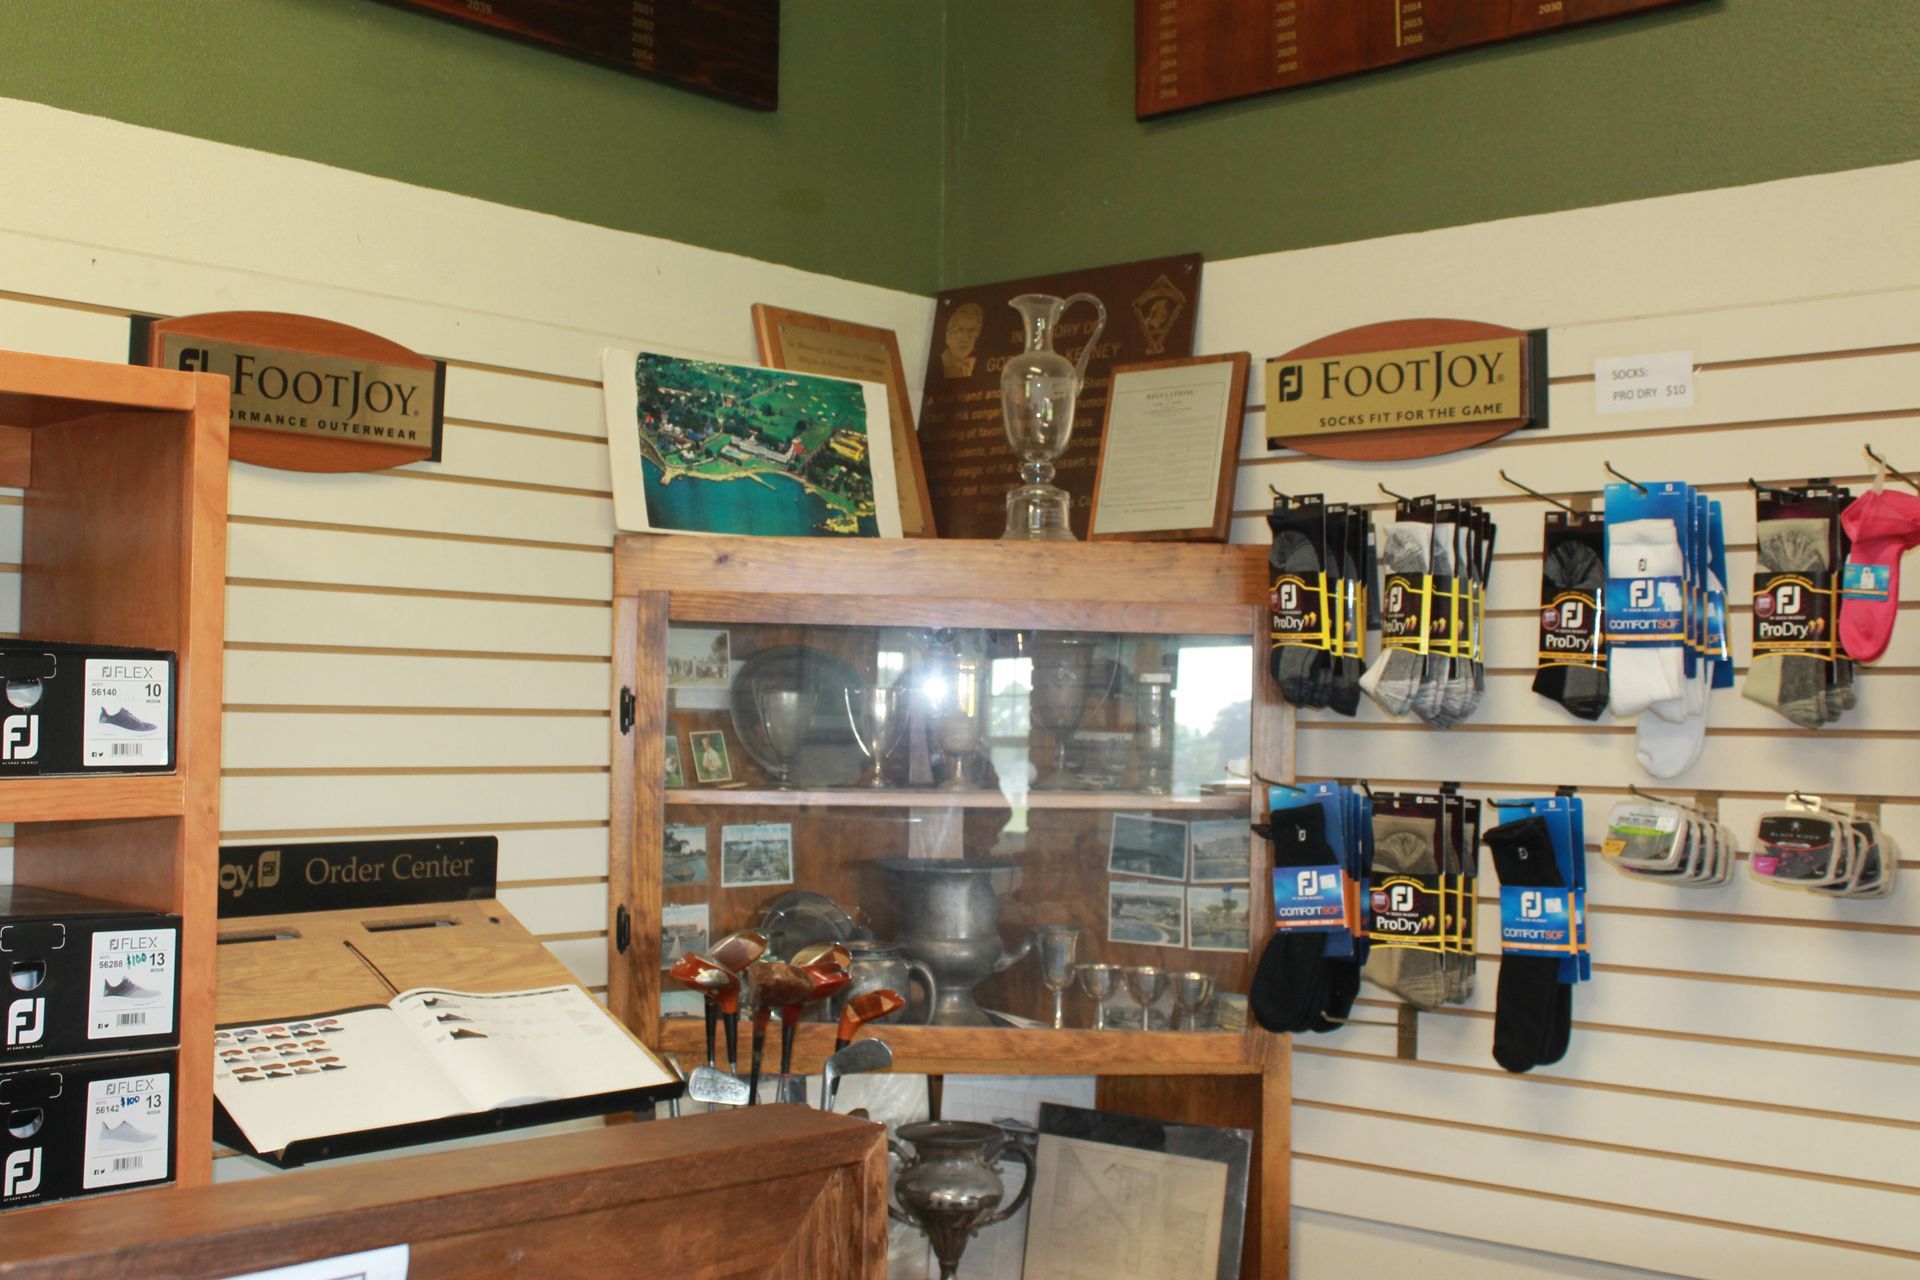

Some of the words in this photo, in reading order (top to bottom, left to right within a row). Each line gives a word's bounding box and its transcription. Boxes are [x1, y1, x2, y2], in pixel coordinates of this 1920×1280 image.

[1279, 365, 1303, 402] FJ
[1320, 350, 1504, 402] FOOTJOY
[1611, 367, 1648, 381] SOCKS:
[232, 353, 417, 420] FOOTJOY
[1612, 389, 1634, 401] PRO
[1636, 387, 1657, 399] DRY
[1666, 384, 1686, 397] $10
[1319, 413, 1365, 428] SOCKS
[1369, 412, 1391, 424] FIT
[1396, 409, 1424, 422] FOR
[1429, 406, 1456, 418] THE
[1462, 402, 1503, 416] GAME
[318, 418, 417, 440] OUTERWEAR
[1281, 584, 1297, 609] FJ
[1630, 580, 1654, 607] FJ
[1777, 586, 1801, 614] FJ
[1273, 615, 1305, 632] ProDry
[1561, 602, 1584, 628] FJ
[1759, 621, 1809, 639] ProDry
[1545, 633, 1590, 652] ProDry
[115, 666, 153, 679] FLEX
[92, 688, 117, 696] 56140
[145, 683, 162, 698] 10
[2, 715, 39, 759] FJ
[305, 854, 385, 886] Order
[391, 853, 474, 880] Center
[1297, 870, 1318, 896] FJ
[1391, 886, 1414, 912] FJ
[1521, 891, 1542, 918] FJ
[1376, 916, 1422, 934] ProDry
[121, 936, 158, 950] FLEX
[99, 960, 124, 969] 56288
[150, 953, 165, 966] 13
[7, 997, 45, 1045] FJ
[118, 1079, 155, 1093] FLEX
[96, 1105, 120, 1115] 56142
[146, 1095, 162, 1109] 13
[4, 1147, 43, 1197] FJ
